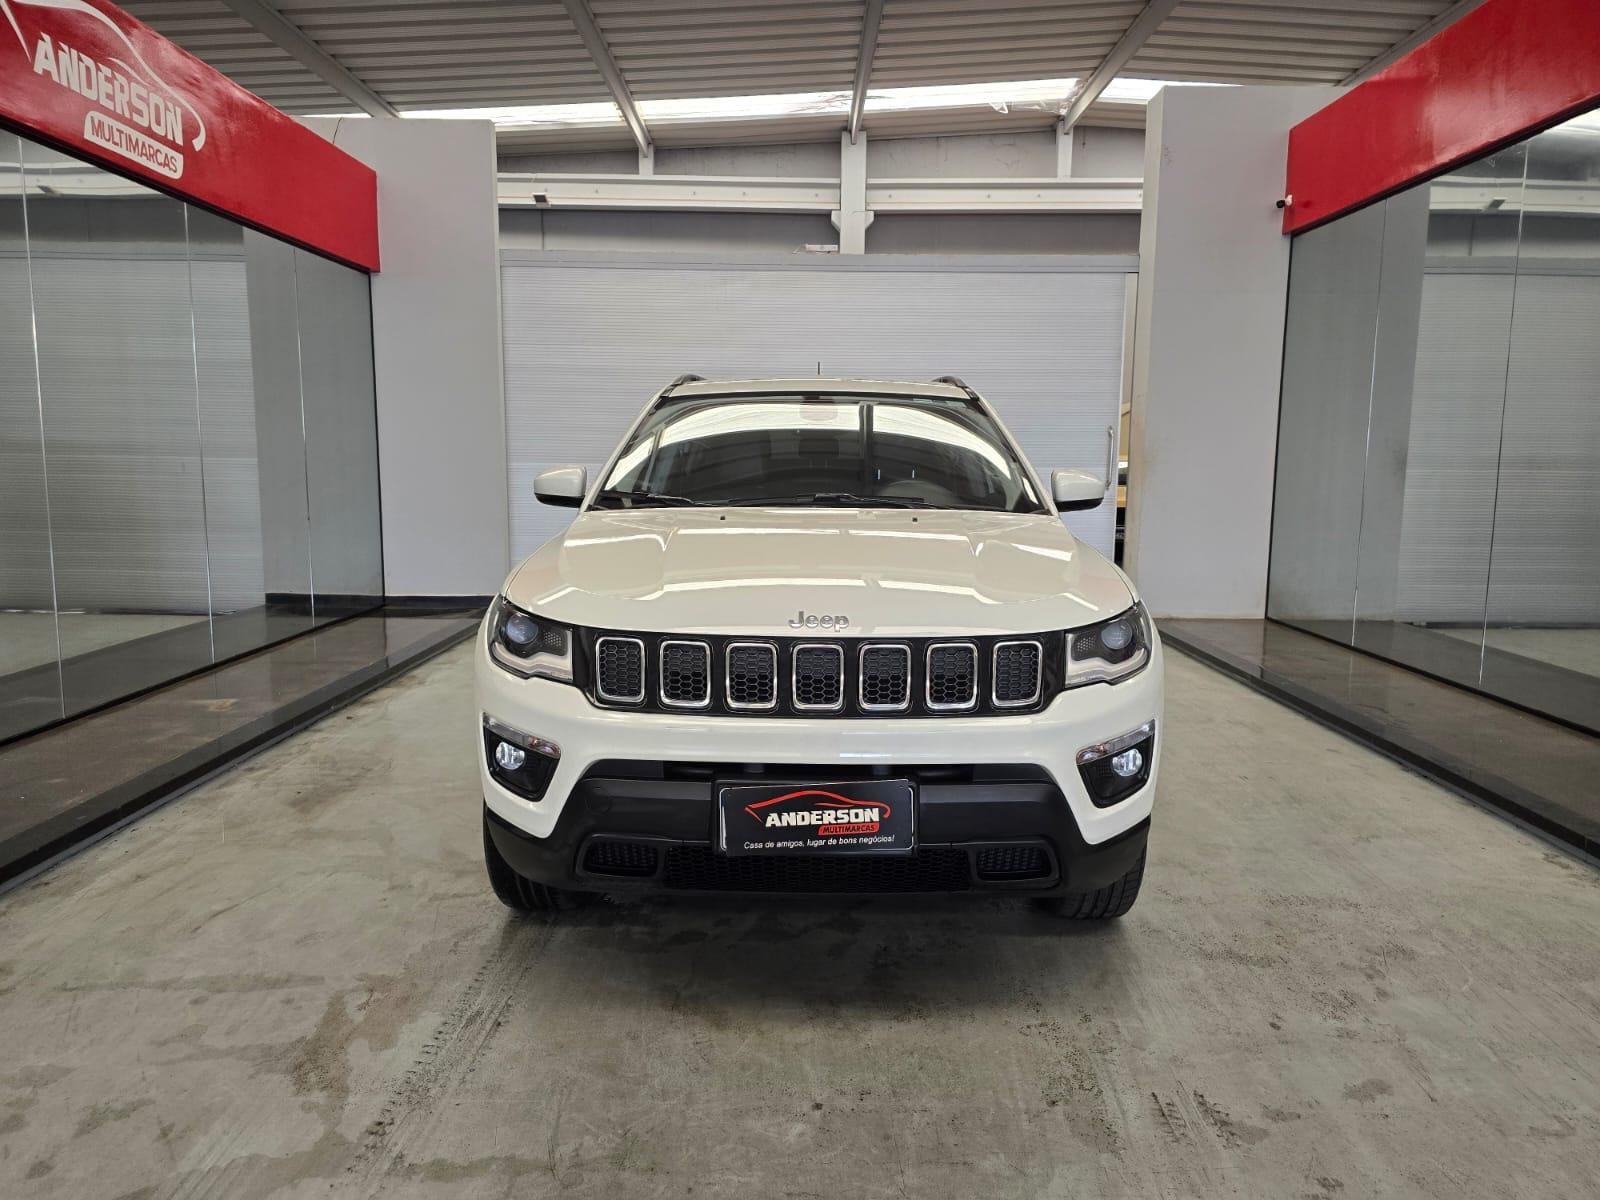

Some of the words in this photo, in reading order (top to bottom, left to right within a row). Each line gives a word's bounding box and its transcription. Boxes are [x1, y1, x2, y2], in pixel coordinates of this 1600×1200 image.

[33, 31, 184, 147] ANDERSON
[90, 116, 178, 174] MULTIMARCAS
[788, 611, 849, 632] Jeep
[765, 808, 880, 827] ANDERSON
[822, 824, 875, 834] MULTIMARCAS
[743, 841, 764, 849] Casa
[776, 840, 805, 849] amigos,
[806, 838, 826, 848] lugar
[827, 837, 837, 845] de
[838, 836, 857, 845] bons
[858, 834, 895, 845] negócios!
